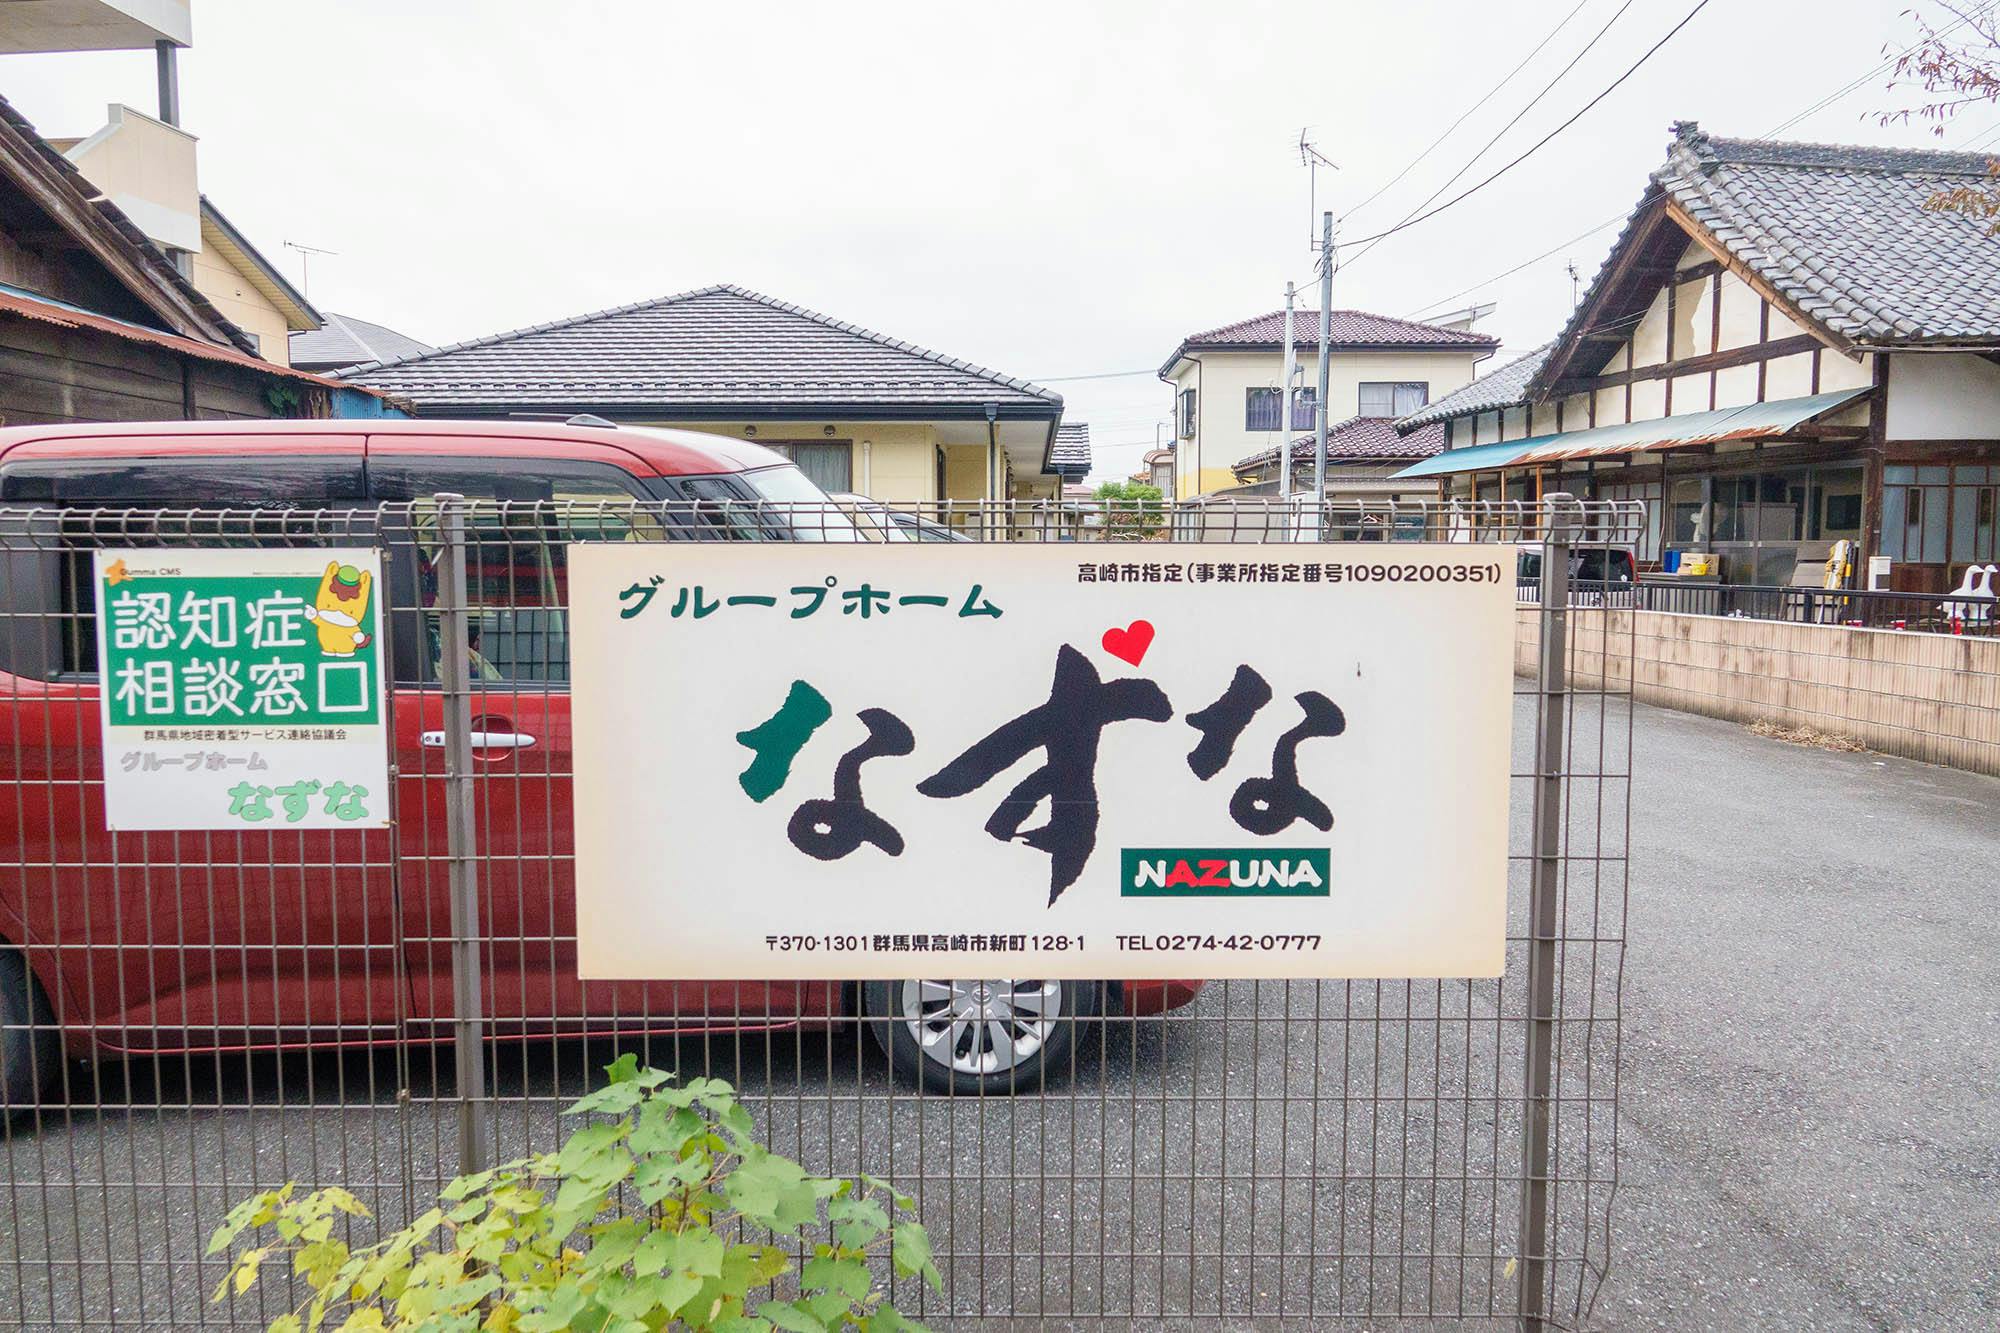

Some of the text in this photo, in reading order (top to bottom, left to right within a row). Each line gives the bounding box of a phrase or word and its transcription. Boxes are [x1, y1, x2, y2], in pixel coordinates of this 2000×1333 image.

[159, 568, 182, 576] CMS
[618, 575, 1004, 620] グループホーム
[111, 589, 307, 650] 認知症
[115, 656, 370, 717] 相談窓口
[143, 729, 348, 741] 群馬県地域密着型サービス連絡協議会
[120, 751, 269, 773] グループホーム
[227, 778, 370, 823] なずな
[1134, 859, 1323, 889] NAZUNA
